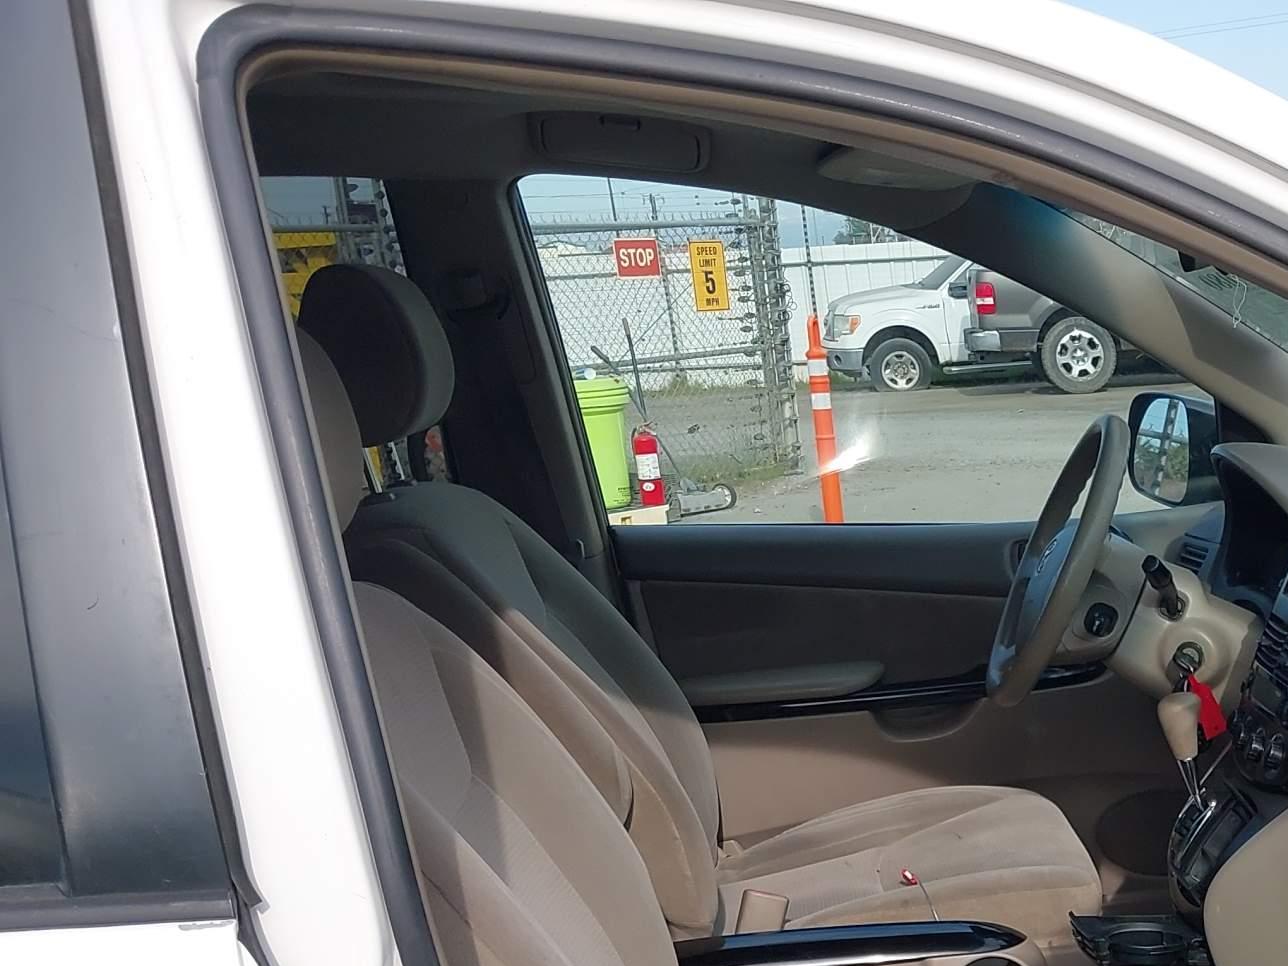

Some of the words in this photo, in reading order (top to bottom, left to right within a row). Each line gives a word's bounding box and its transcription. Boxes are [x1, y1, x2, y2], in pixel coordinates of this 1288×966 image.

[696, 246, 718, 256] SPEED
[619, 248, 655, 267] STOP
[698, 258, 717, 268] LIMIT
[702, 270, 716, 294] 5
[705, 297, 720, 307] MPH
